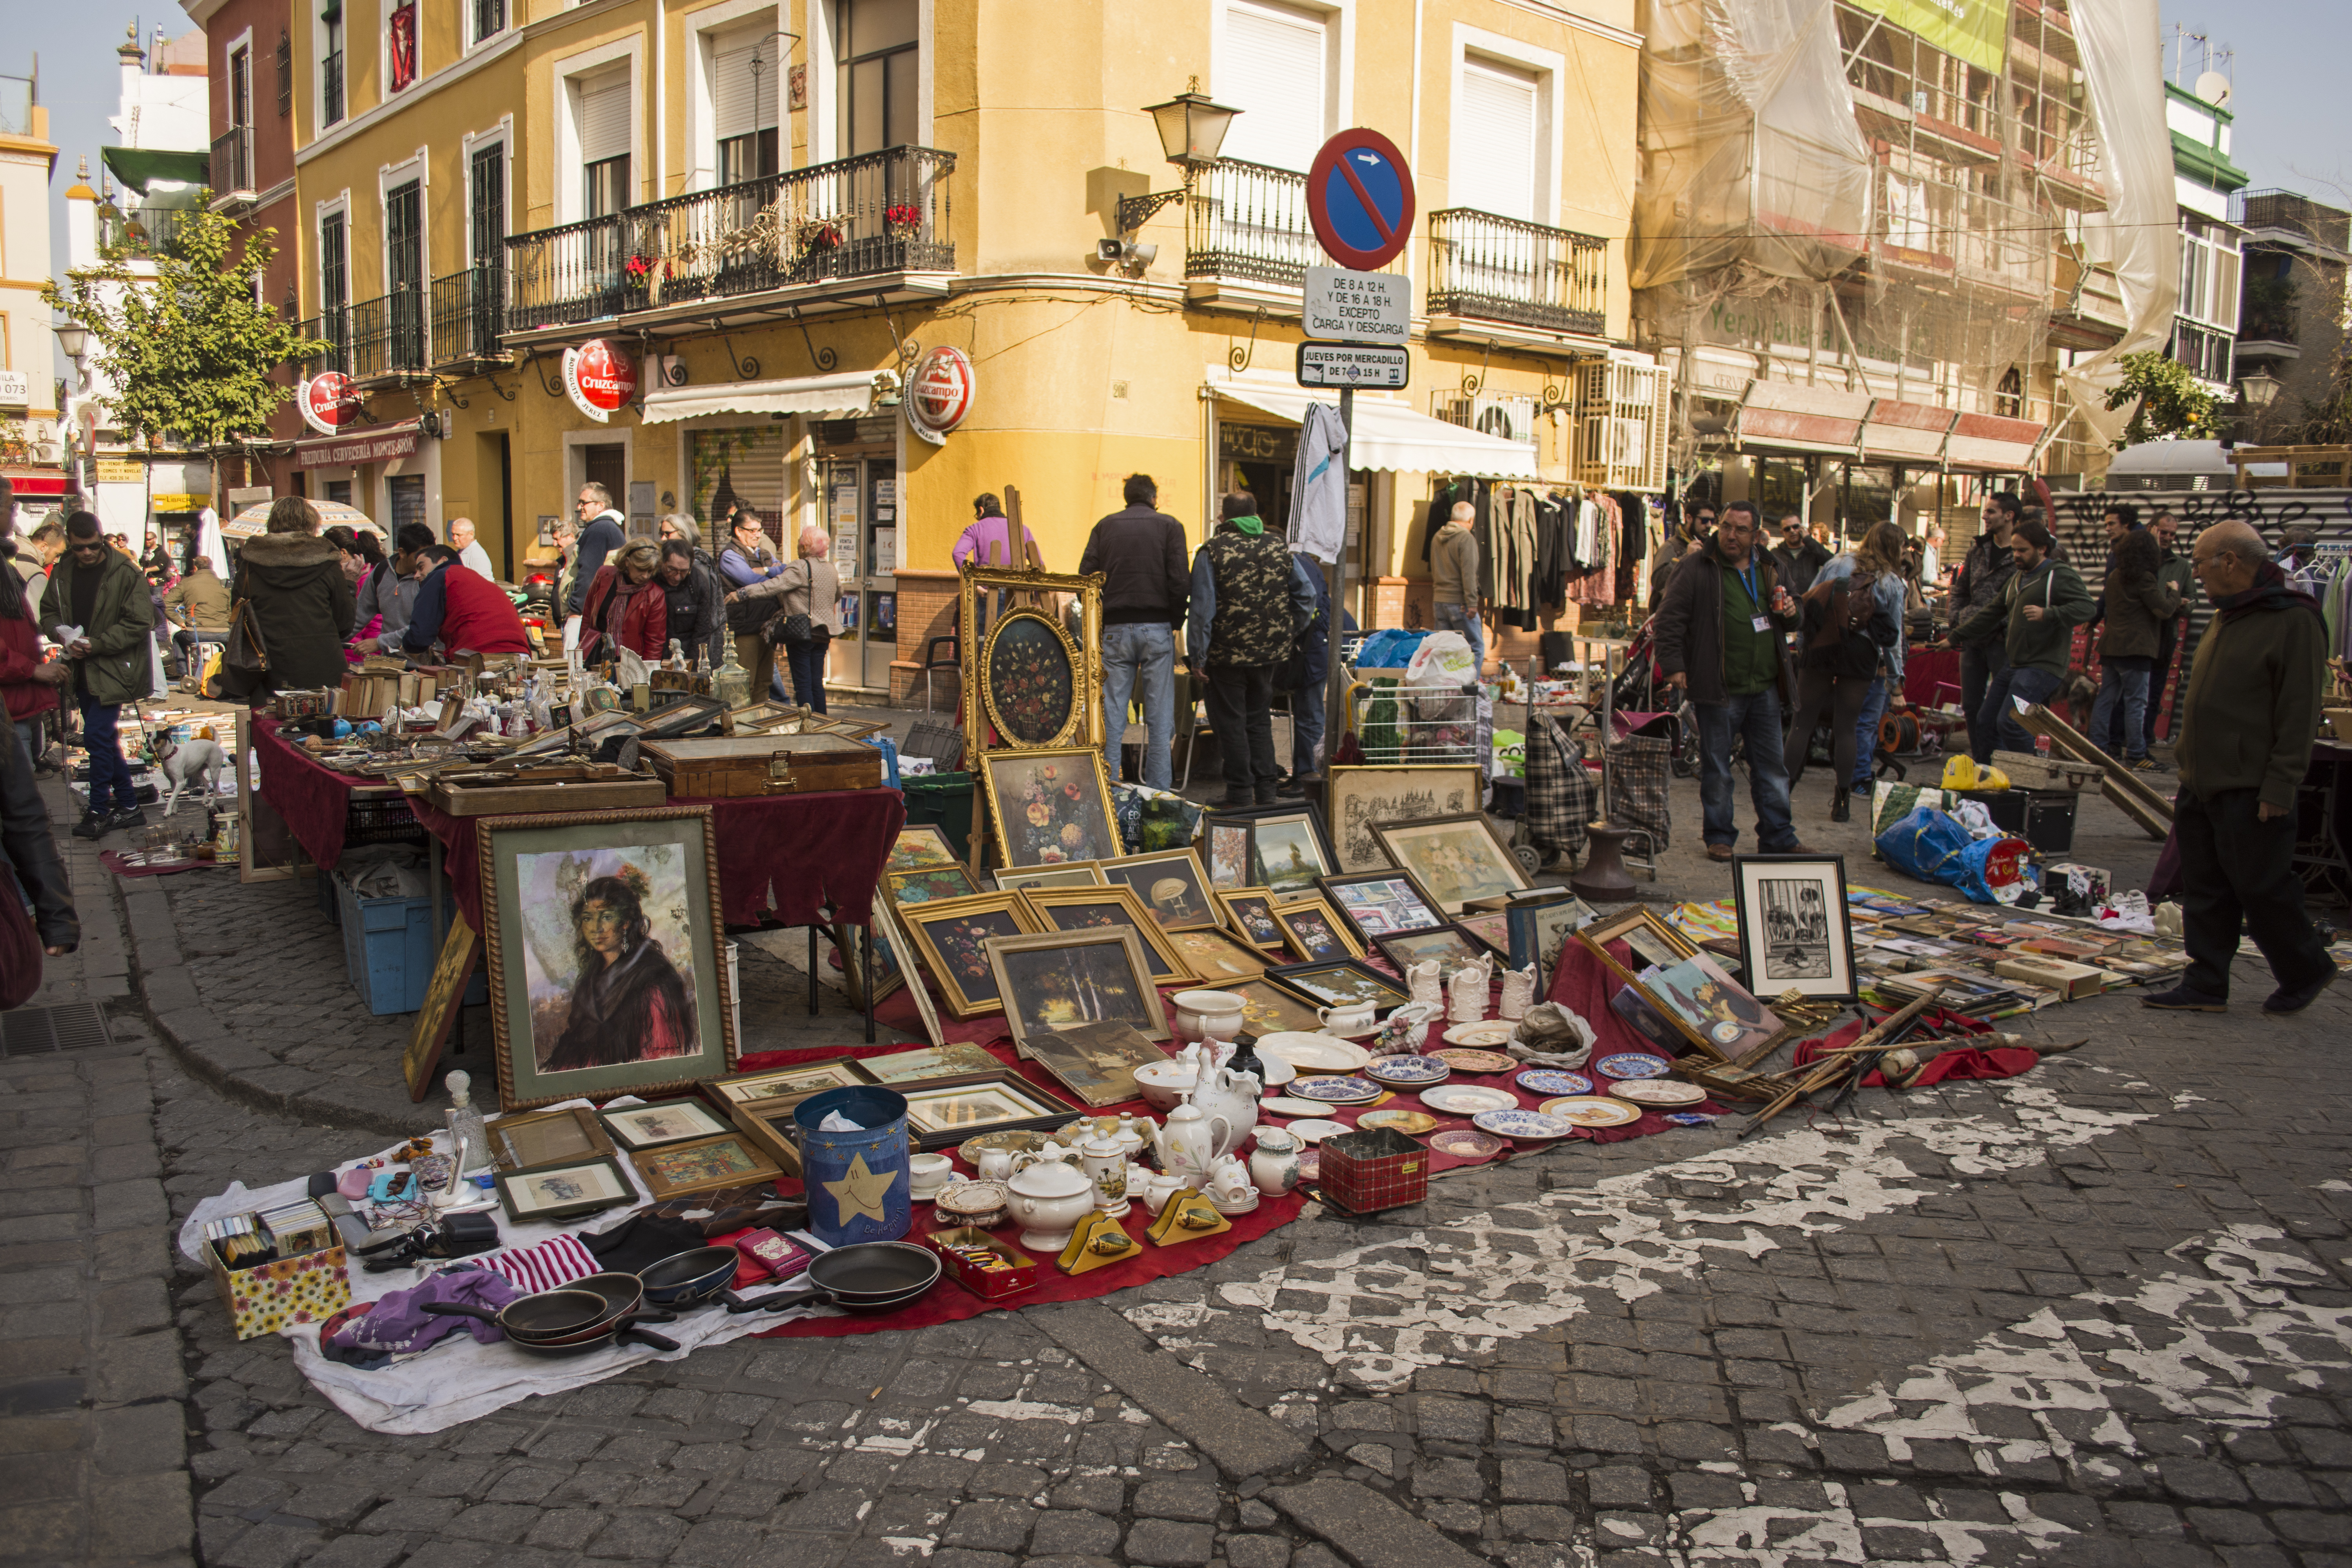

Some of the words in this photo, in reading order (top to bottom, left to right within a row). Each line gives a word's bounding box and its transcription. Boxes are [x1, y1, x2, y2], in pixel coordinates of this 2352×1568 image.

[1334, 278, 1346, 289] DE
[1349, 280, 1354, 290] 8
[1357, 281, 1364, 290] A
[1367, 281, 1376, 292] 12
[1378, 283, 1386, 293] H.
[1328, 291, 1333, 301] Y
[1336, 292, 1348, 303] DE
[1351, 294, 1360, 304] 16
[1363, 295, 1369, 305] A
[1373, 296, 1381, 306] 18
[1384, 297, 1392, 307] H.
[1339, 306, 1380, 319] EXCEPTO
[1313, 318, 1345, 330] CARGA
[1348, 321, 1353, 331] Y
[1357, 321, 1404, 335] DESCARGA
[1305, 352, 1334, 361] JUEVES
[1336, 353, 1352, 362] POR
[1355, 354, 1403, 365] MERCADILLO
[568, 357, 580, 400] BODEGUITA
[1330, 367, 1339, 375] DE
[1363, 368, 1372, 377] 15
[1374, 369, 1380, 377] H
[5, 385, 26, 394] 073
[582, 376, 635, 393] Cruzcampo
[582, 403, 601, 417] JEREZ
[918, 427, 935, 440] MARIO
[301, 445, 332, 465] FREIDURÍA
[333, 440, 371, 462] CERVECERÍA
[864, 1224, 875, 1233] Be
[877, 1214, 900, 1235] Happy
